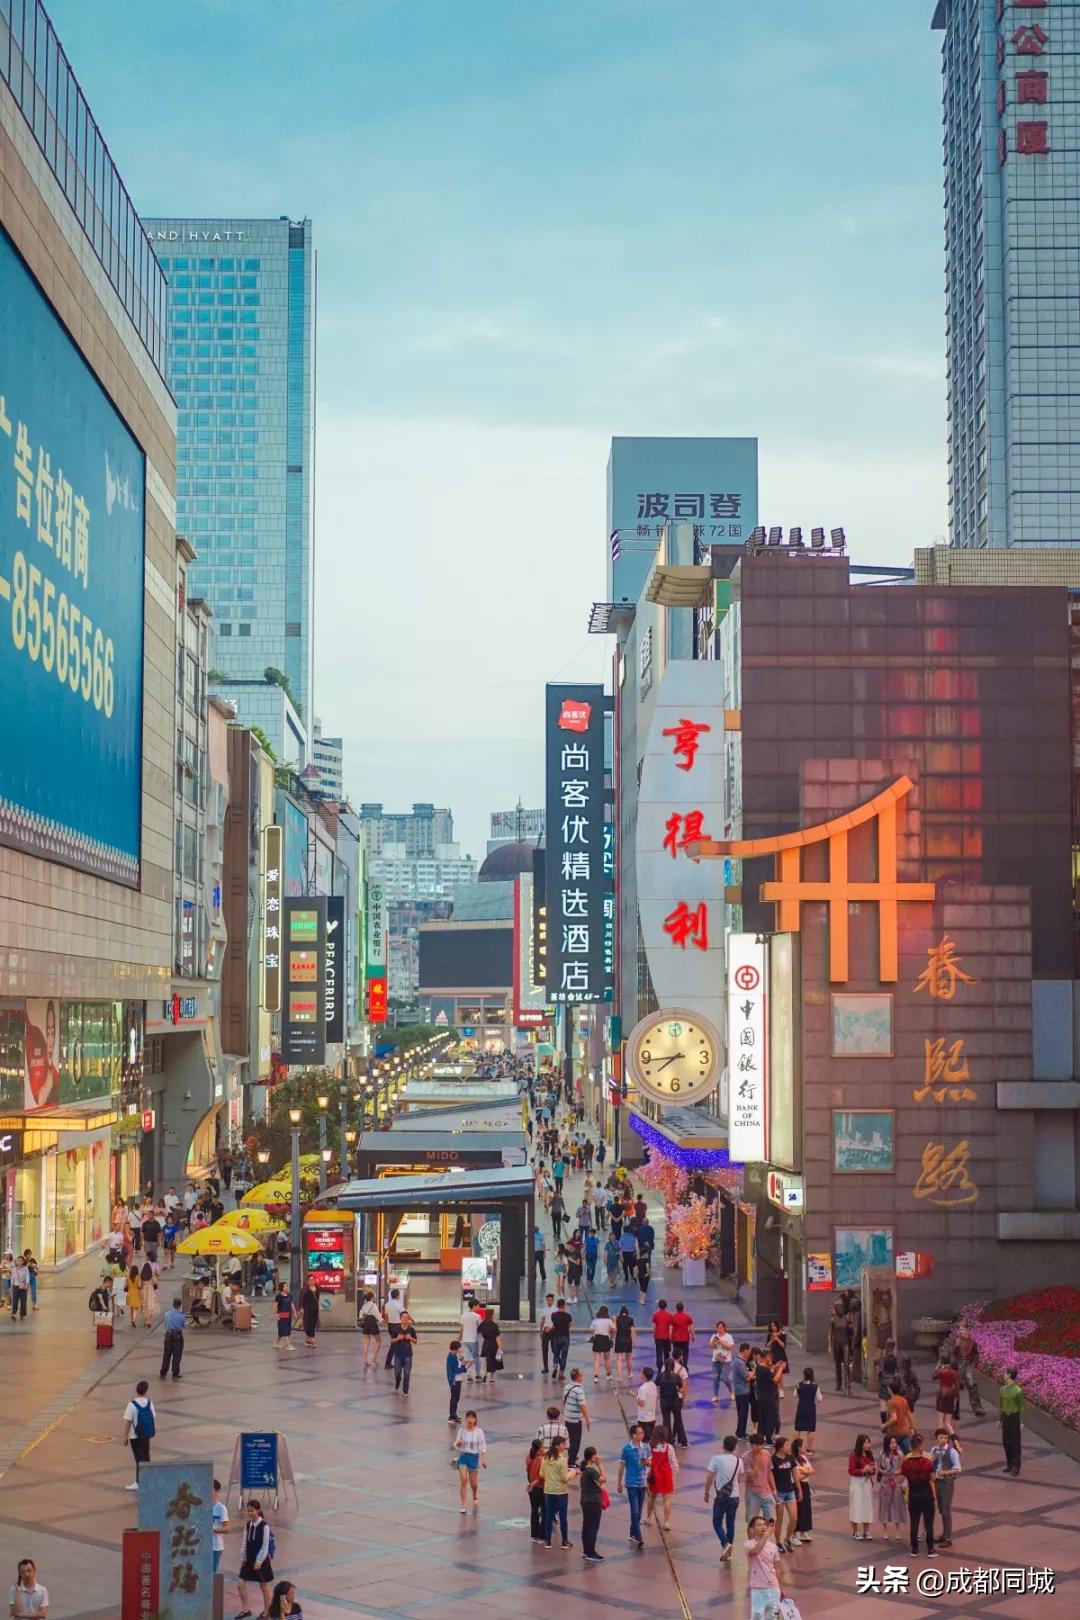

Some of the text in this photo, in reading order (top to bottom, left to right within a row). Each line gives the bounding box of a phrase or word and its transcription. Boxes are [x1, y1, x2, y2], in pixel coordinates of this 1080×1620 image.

[190, 231, 244, 240] HYATT
[637, 493, 742, 519] 波司登
[662, 719, 711, 951] 亨得利
[561, 742, 590, 990] 尚客优精选酒店
[265, 869, 280, 968] 爱恋珠宝
[372, 903, 382, 957] 中国农业银行
[641, 1050, 709, 1064] 9 3
[913, 935, 979, 1207] 春熙路
[670, 1078, 680, 1092] 6
[426, 1151, 458, 1160] MIDO
